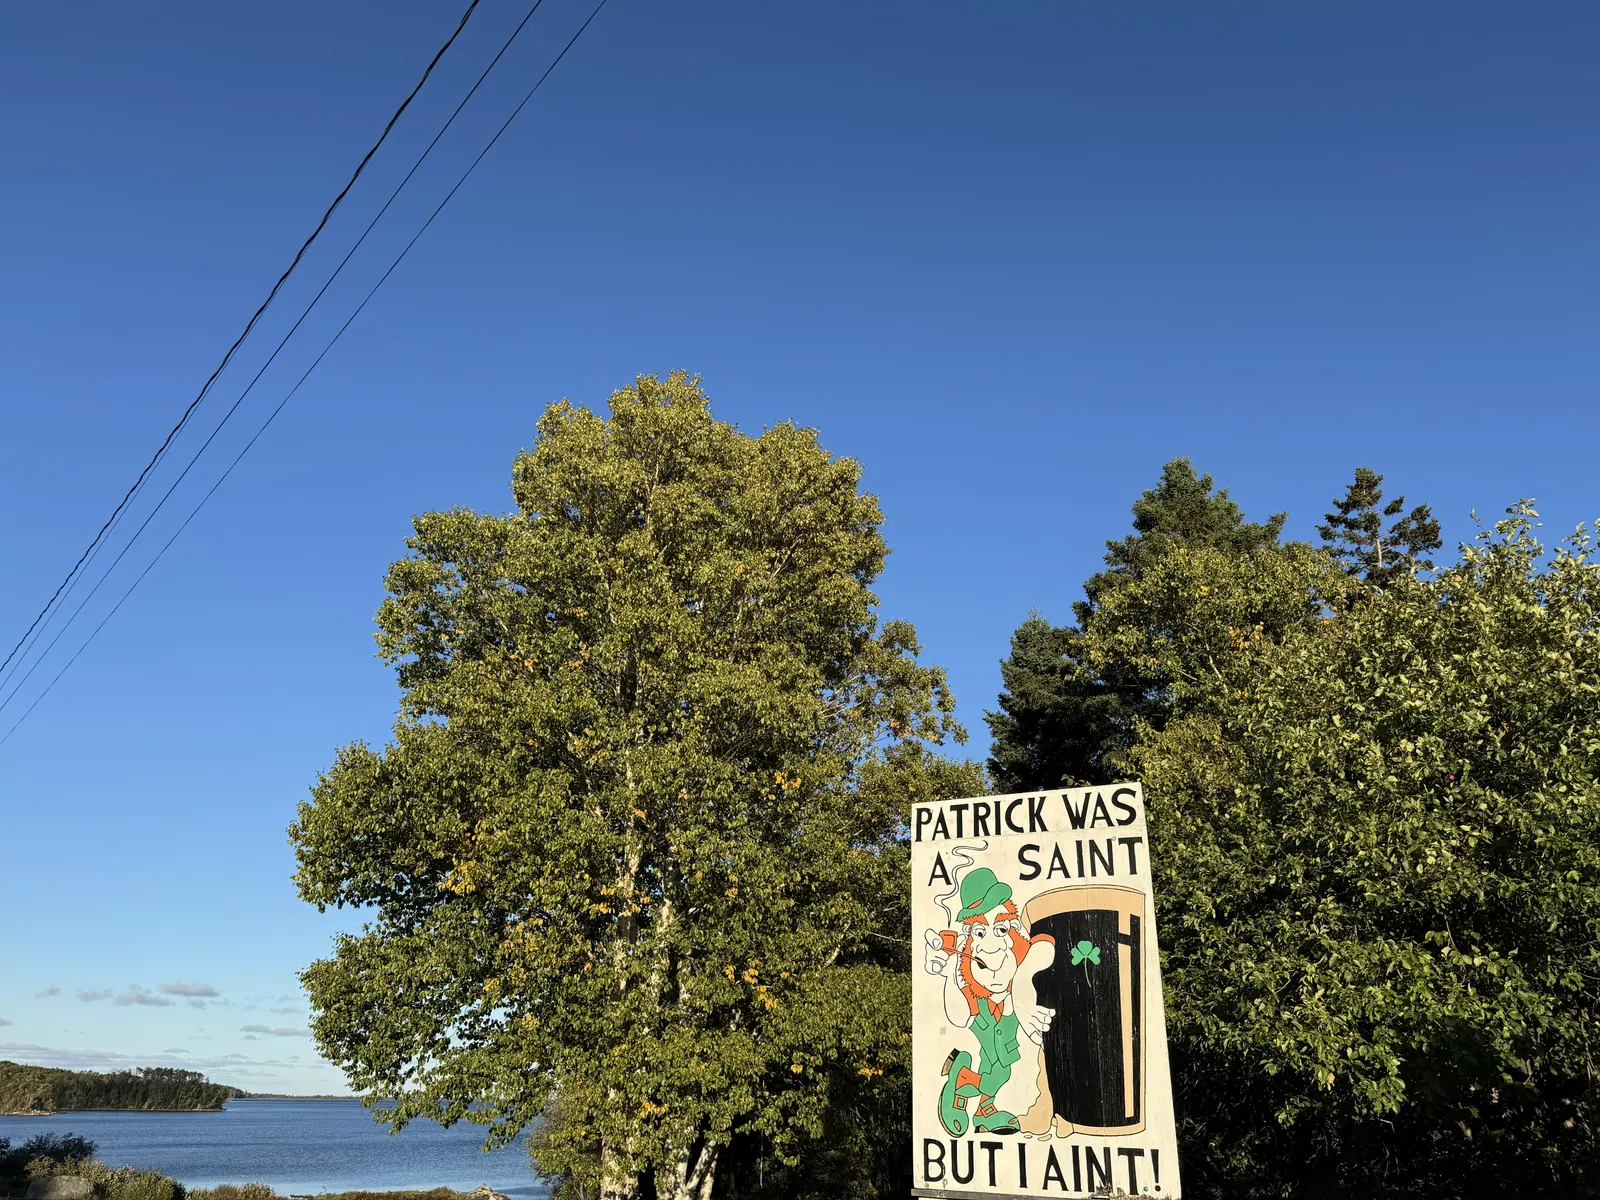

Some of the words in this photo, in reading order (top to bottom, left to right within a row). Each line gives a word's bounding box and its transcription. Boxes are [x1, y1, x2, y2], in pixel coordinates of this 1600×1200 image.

[915, 796, 1049, 842] PATRICK
[1062, 787, 1137, 830] WAS
[927, 850, 952, 887] A
[1017, 836, 1143, 881] SAINT
[923, 1138, 1004, 1187] BUT
[1017, 1142, 1028, 1189] I
[1042, 1143, 1161, 1196] AINT!
